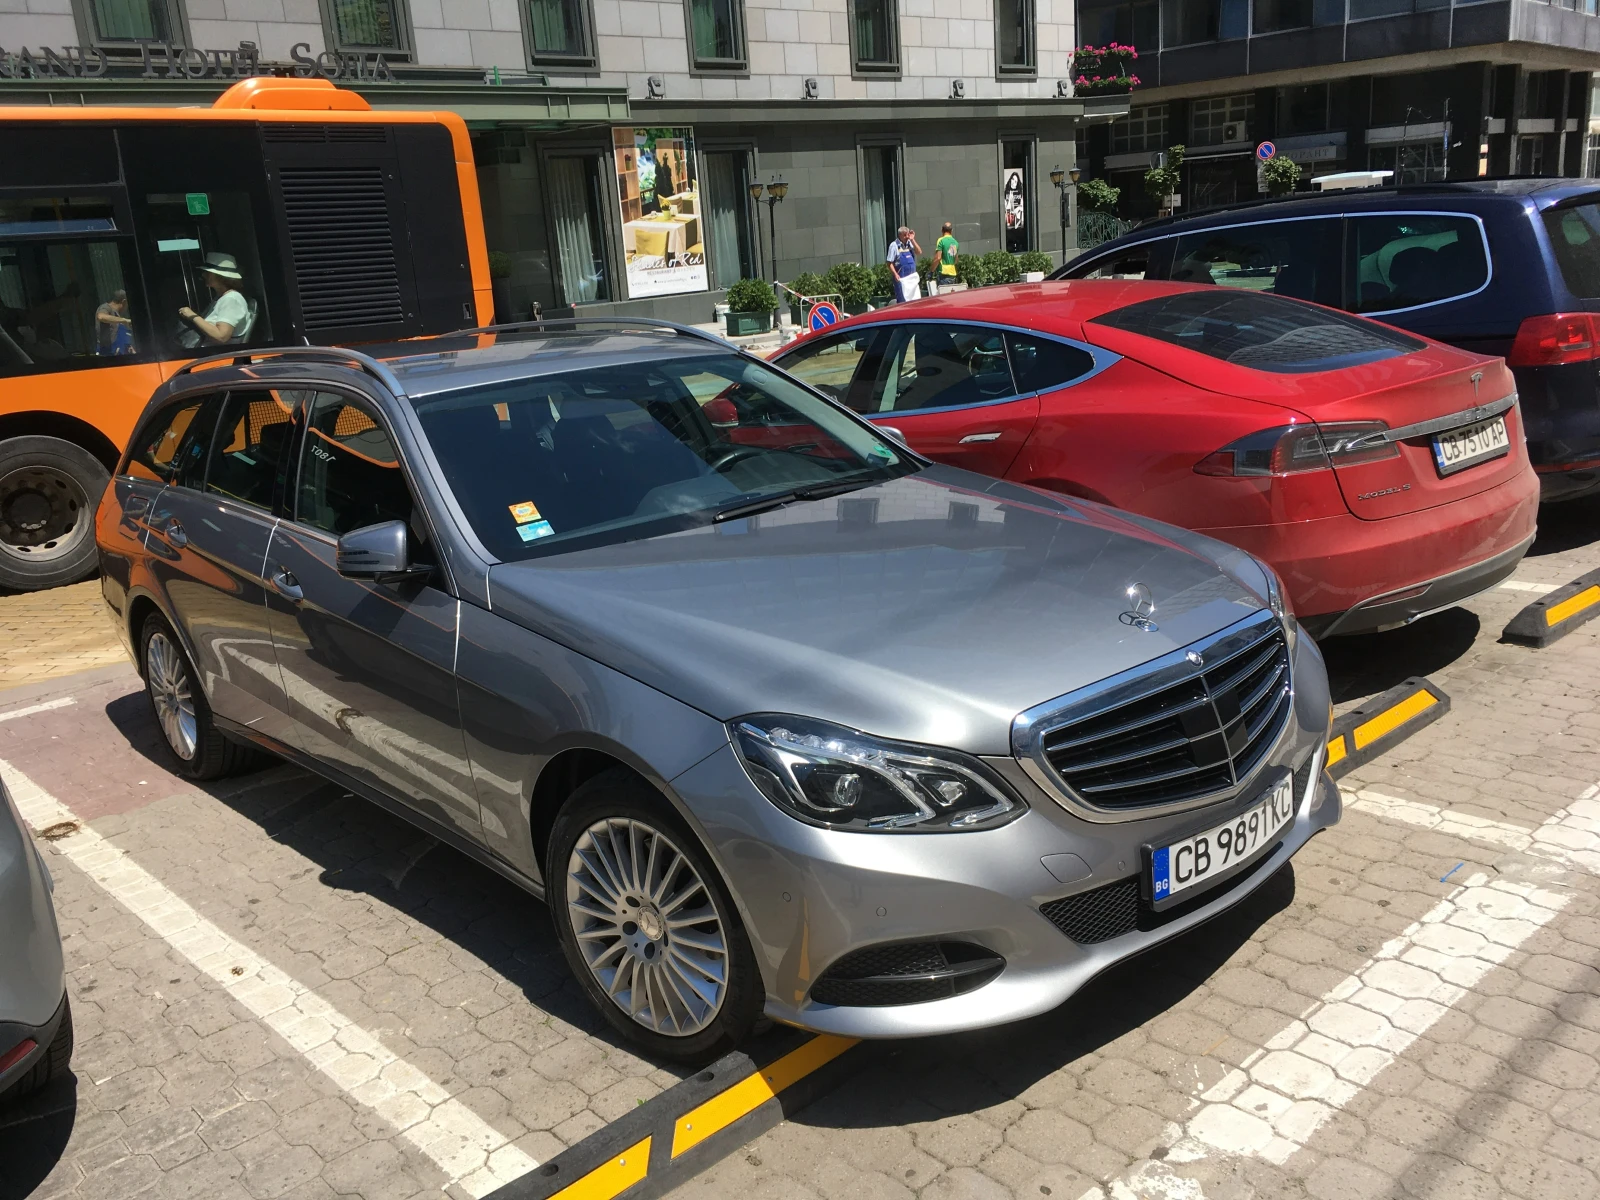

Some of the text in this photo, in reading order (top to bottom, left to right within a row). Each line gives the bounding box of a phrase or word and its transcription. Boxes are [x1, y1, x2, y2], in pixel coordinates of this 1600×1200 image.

[135, 39, 277, 78] HOTEL
[291, 43, 396, 81] SOFIA
[679, 252, 702, 268] Red
[1441, 421, 1504, 462] CB 7510 AP
[1357, 483, 1411, 501] MODEL S
[1175, 782, 1291, 884] CB 9891 KC
[1155, 878, 1169, 893] BG
